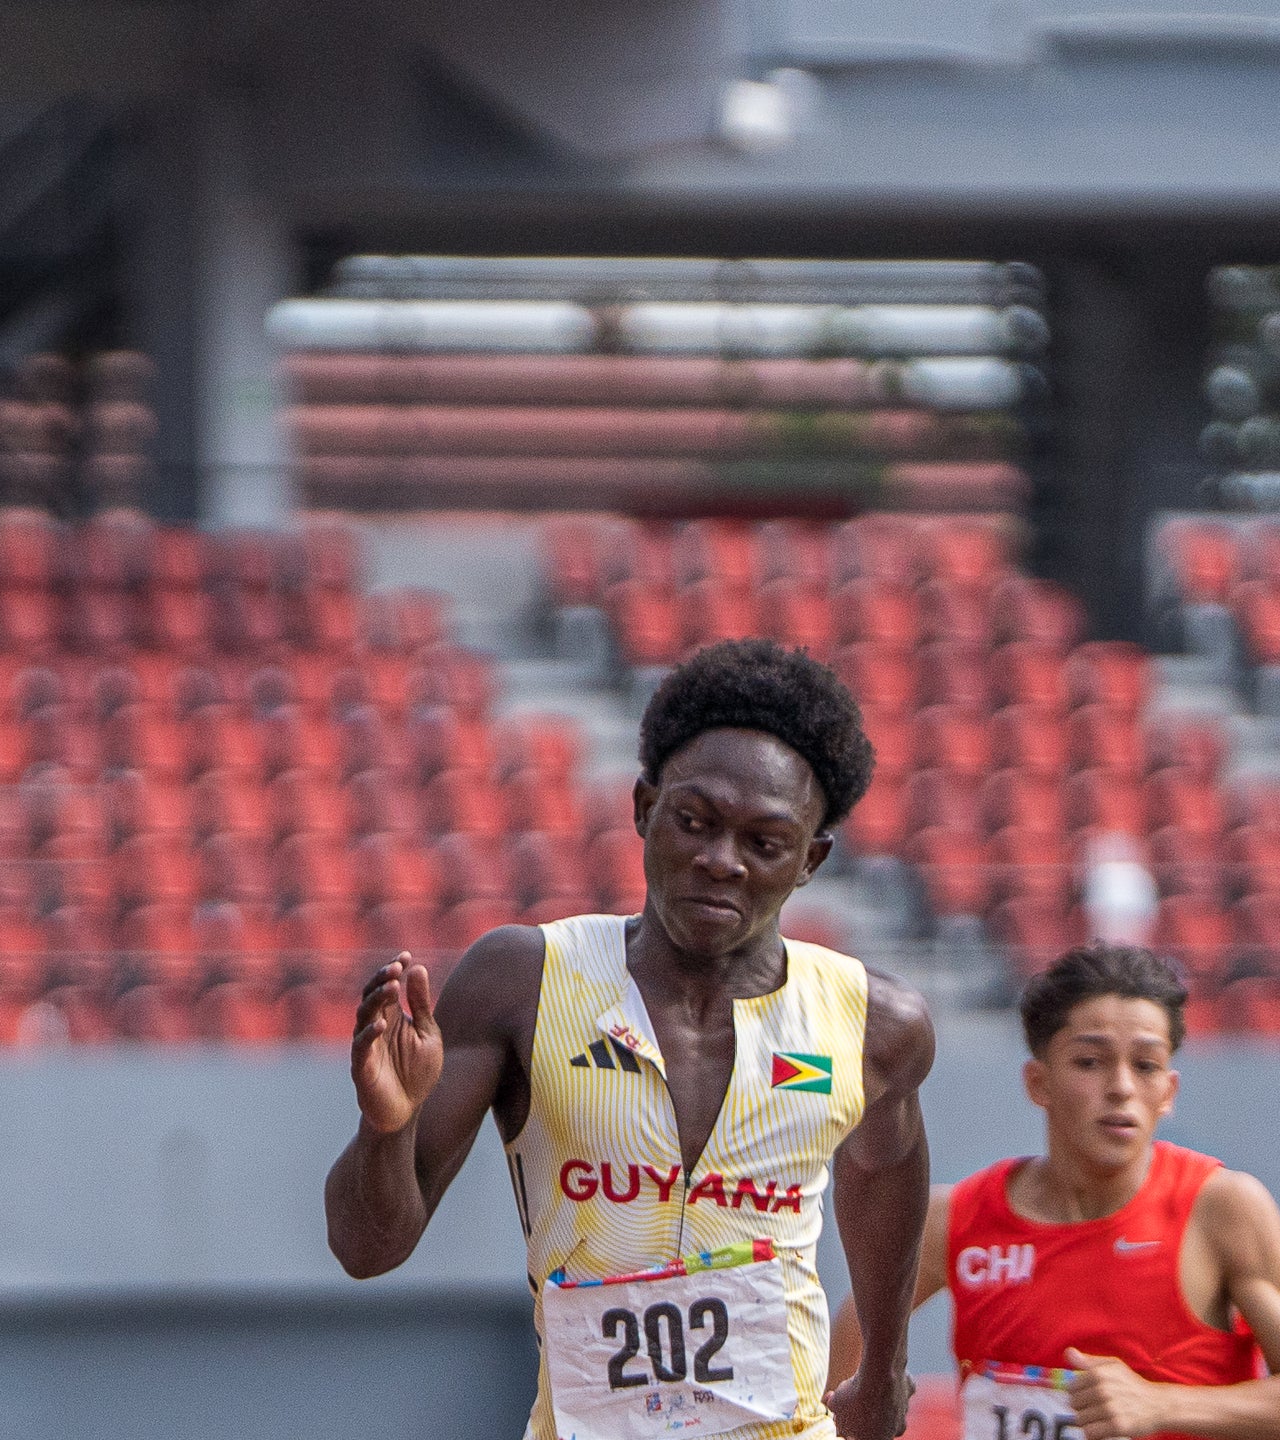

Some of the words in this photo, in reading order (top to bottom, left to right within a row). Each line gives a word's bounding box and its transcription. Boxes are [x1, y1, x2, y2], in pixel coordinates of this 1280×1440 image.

[558, 1158, 802, 1213] GUYANA
[956, 1243, 1036, 1285] CHI
[601, 1297, 735, 1390] 202
